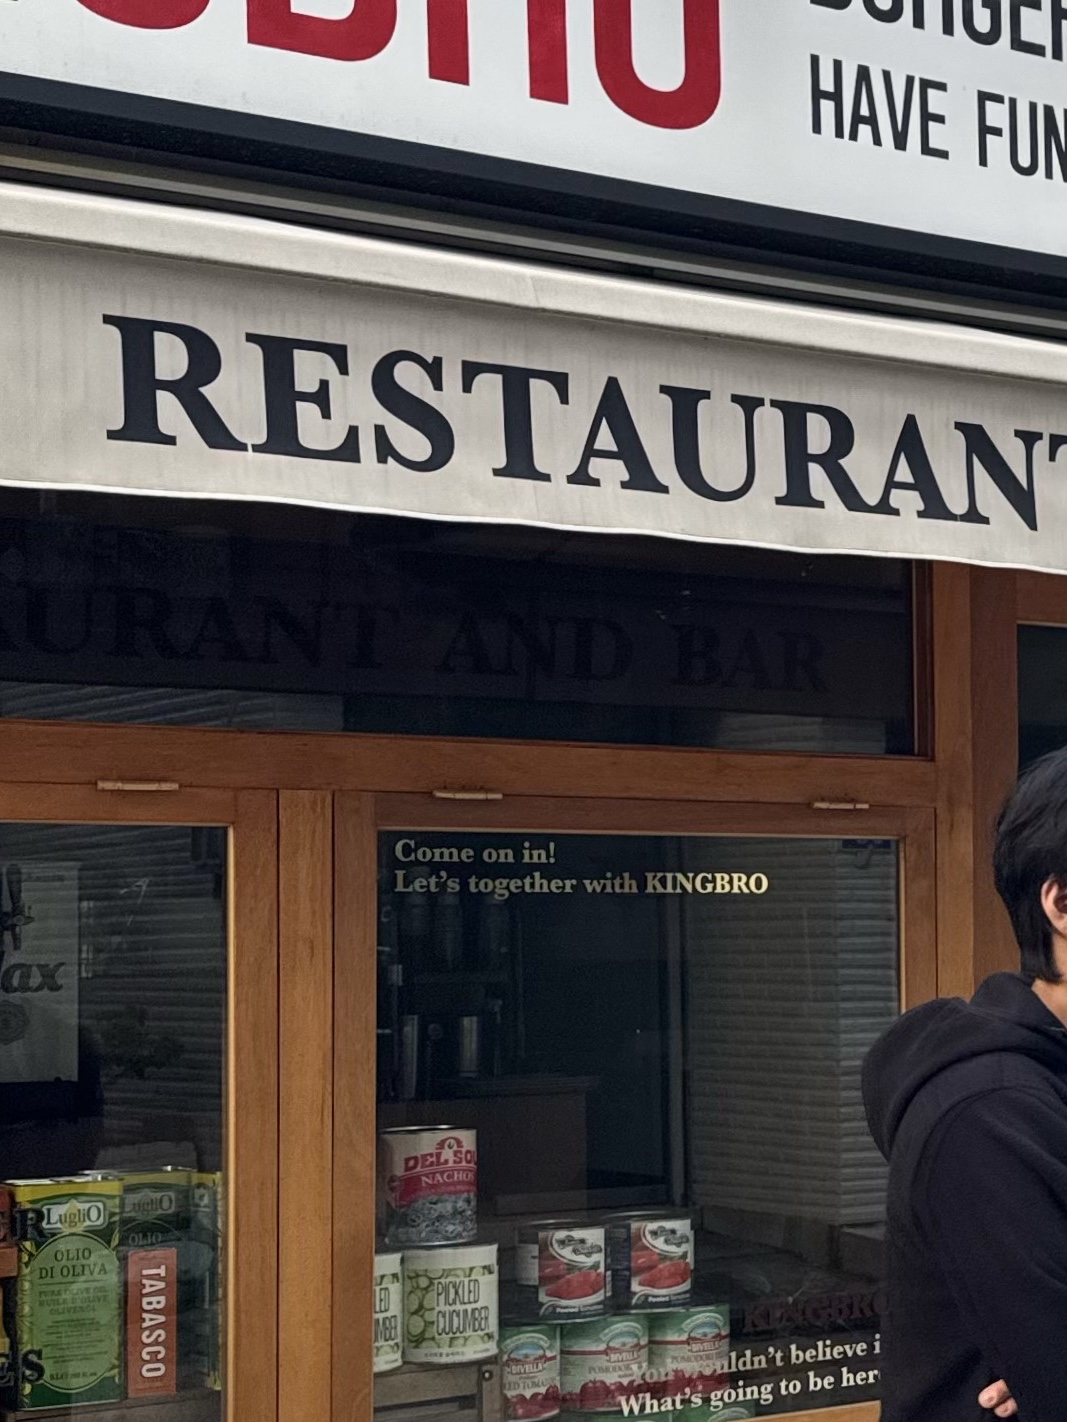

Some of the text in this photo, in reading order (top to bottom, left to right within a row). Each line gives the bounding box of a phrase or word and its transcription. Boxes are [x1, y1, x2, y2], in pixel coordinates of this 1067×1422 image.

[809, 53, 950, 162] HAVE
[395, 839, 556, 864] Come on in!
[394, 870, 769, 900] Let's together with KINGBRO
[1, 962, 66, 993] ax
[404, 1151, 449, 1172] DEL
[54, 1248, 92, 1262] OLIO
[39, 1262, 108, 1280] DI OLIVA
[436, 1279, 480, 1307] PICKLED
[141, 1264, 166, 1379] TABASCO
[436, 1306, 490, 1336] CUCUMBER
[790, 1339, 868, 1366] believe
[873, 1333, 881, 1354] i
[619, 1387, 703, 1417] What's
[710, 1380, 774, 1412] going
[780, 1378, 801, 1395] to
[808, 1371, 835, 1391] be
[841, 1367, 881, 1388] her
